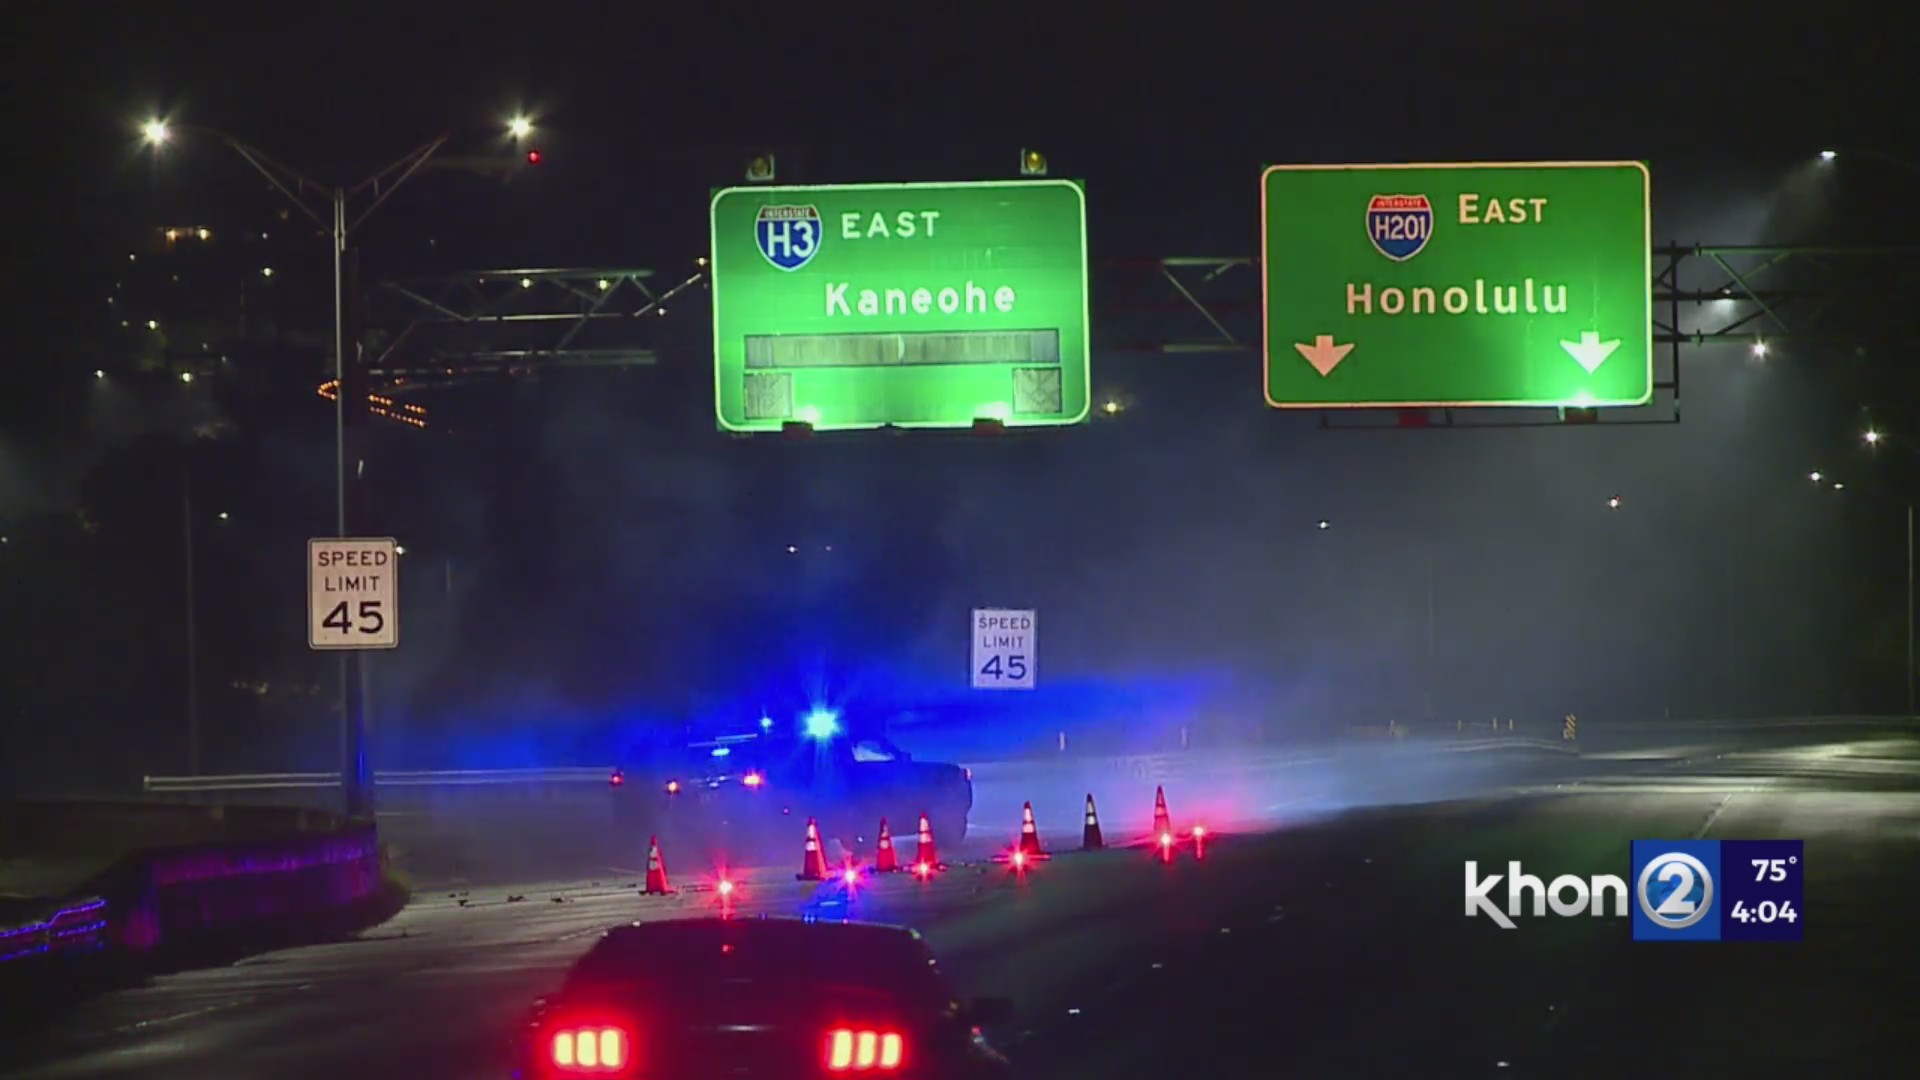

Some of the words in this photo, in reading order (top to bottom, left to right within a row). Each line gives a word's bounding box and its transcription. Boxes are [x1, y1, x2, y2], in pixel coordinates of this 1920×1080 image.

[1458, 194, 1548, 224] EAST
[842, 211, 941, 239] EAST
[1375, 215, 1426, 240] H201
[767, 220, 814, 258] H3
[825, 281, 1016, 317] Kaneohe
[1346, 278, 1568, 314] Honolulu
[318, 551, 388, 567] SPEED
[325, 576, 380, 592] LIMIT
[322, 601, 385, 634] 45
[978, 617, 1031, 630] SPEED
[983, 636, 1024, 648] LIMIT
[980, 655, 1027, 680] 45
